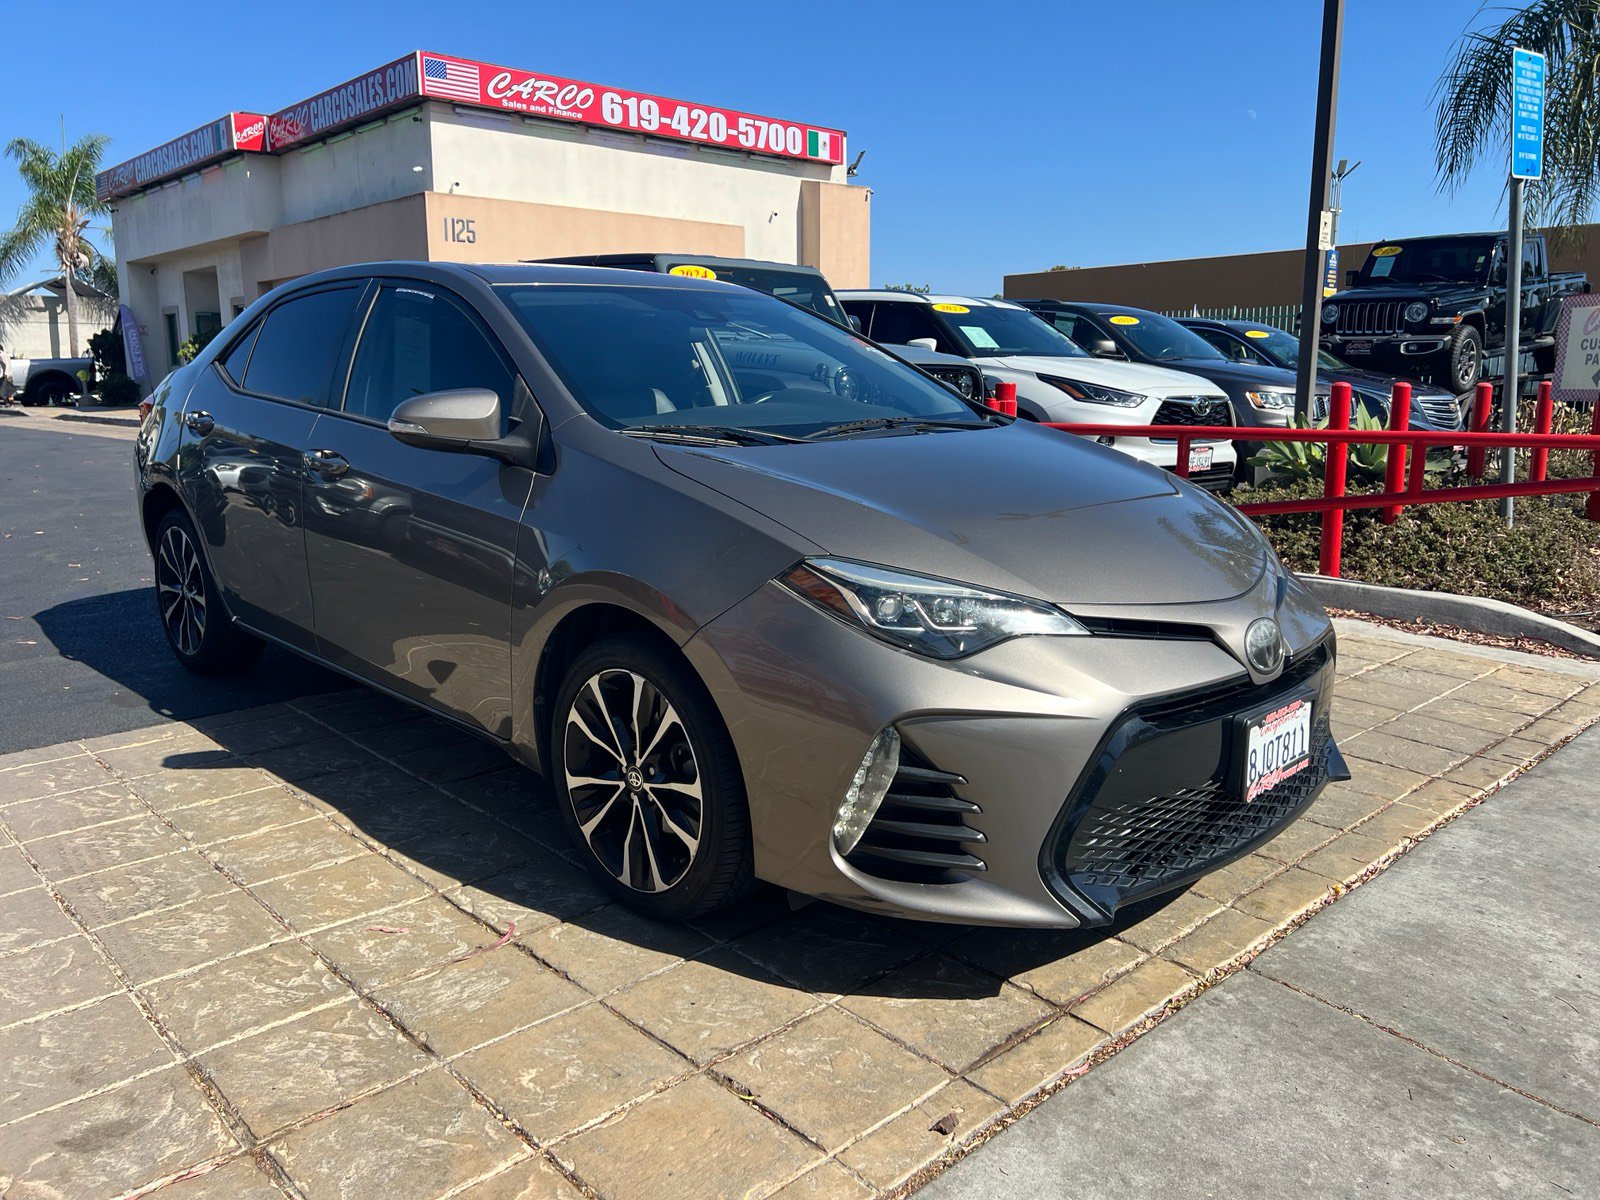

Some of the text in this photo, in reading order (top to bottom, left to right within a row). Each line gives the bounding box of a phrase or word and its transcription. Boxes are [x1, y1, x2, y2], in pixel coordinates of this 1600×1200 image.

[270, 58, 418, 143] CARCO CARCOSALES.COM
[487, 72, 594, 110] CARCO
[502, 99, 582, 118] Sales and Finance
[235, 121, 265, 142] CARCO
[602, 91, 803, 155] 619-420-5700
[135, 126, 214, 182] CARCOSALES.COM
[444, 217, 476, 243] 1125
